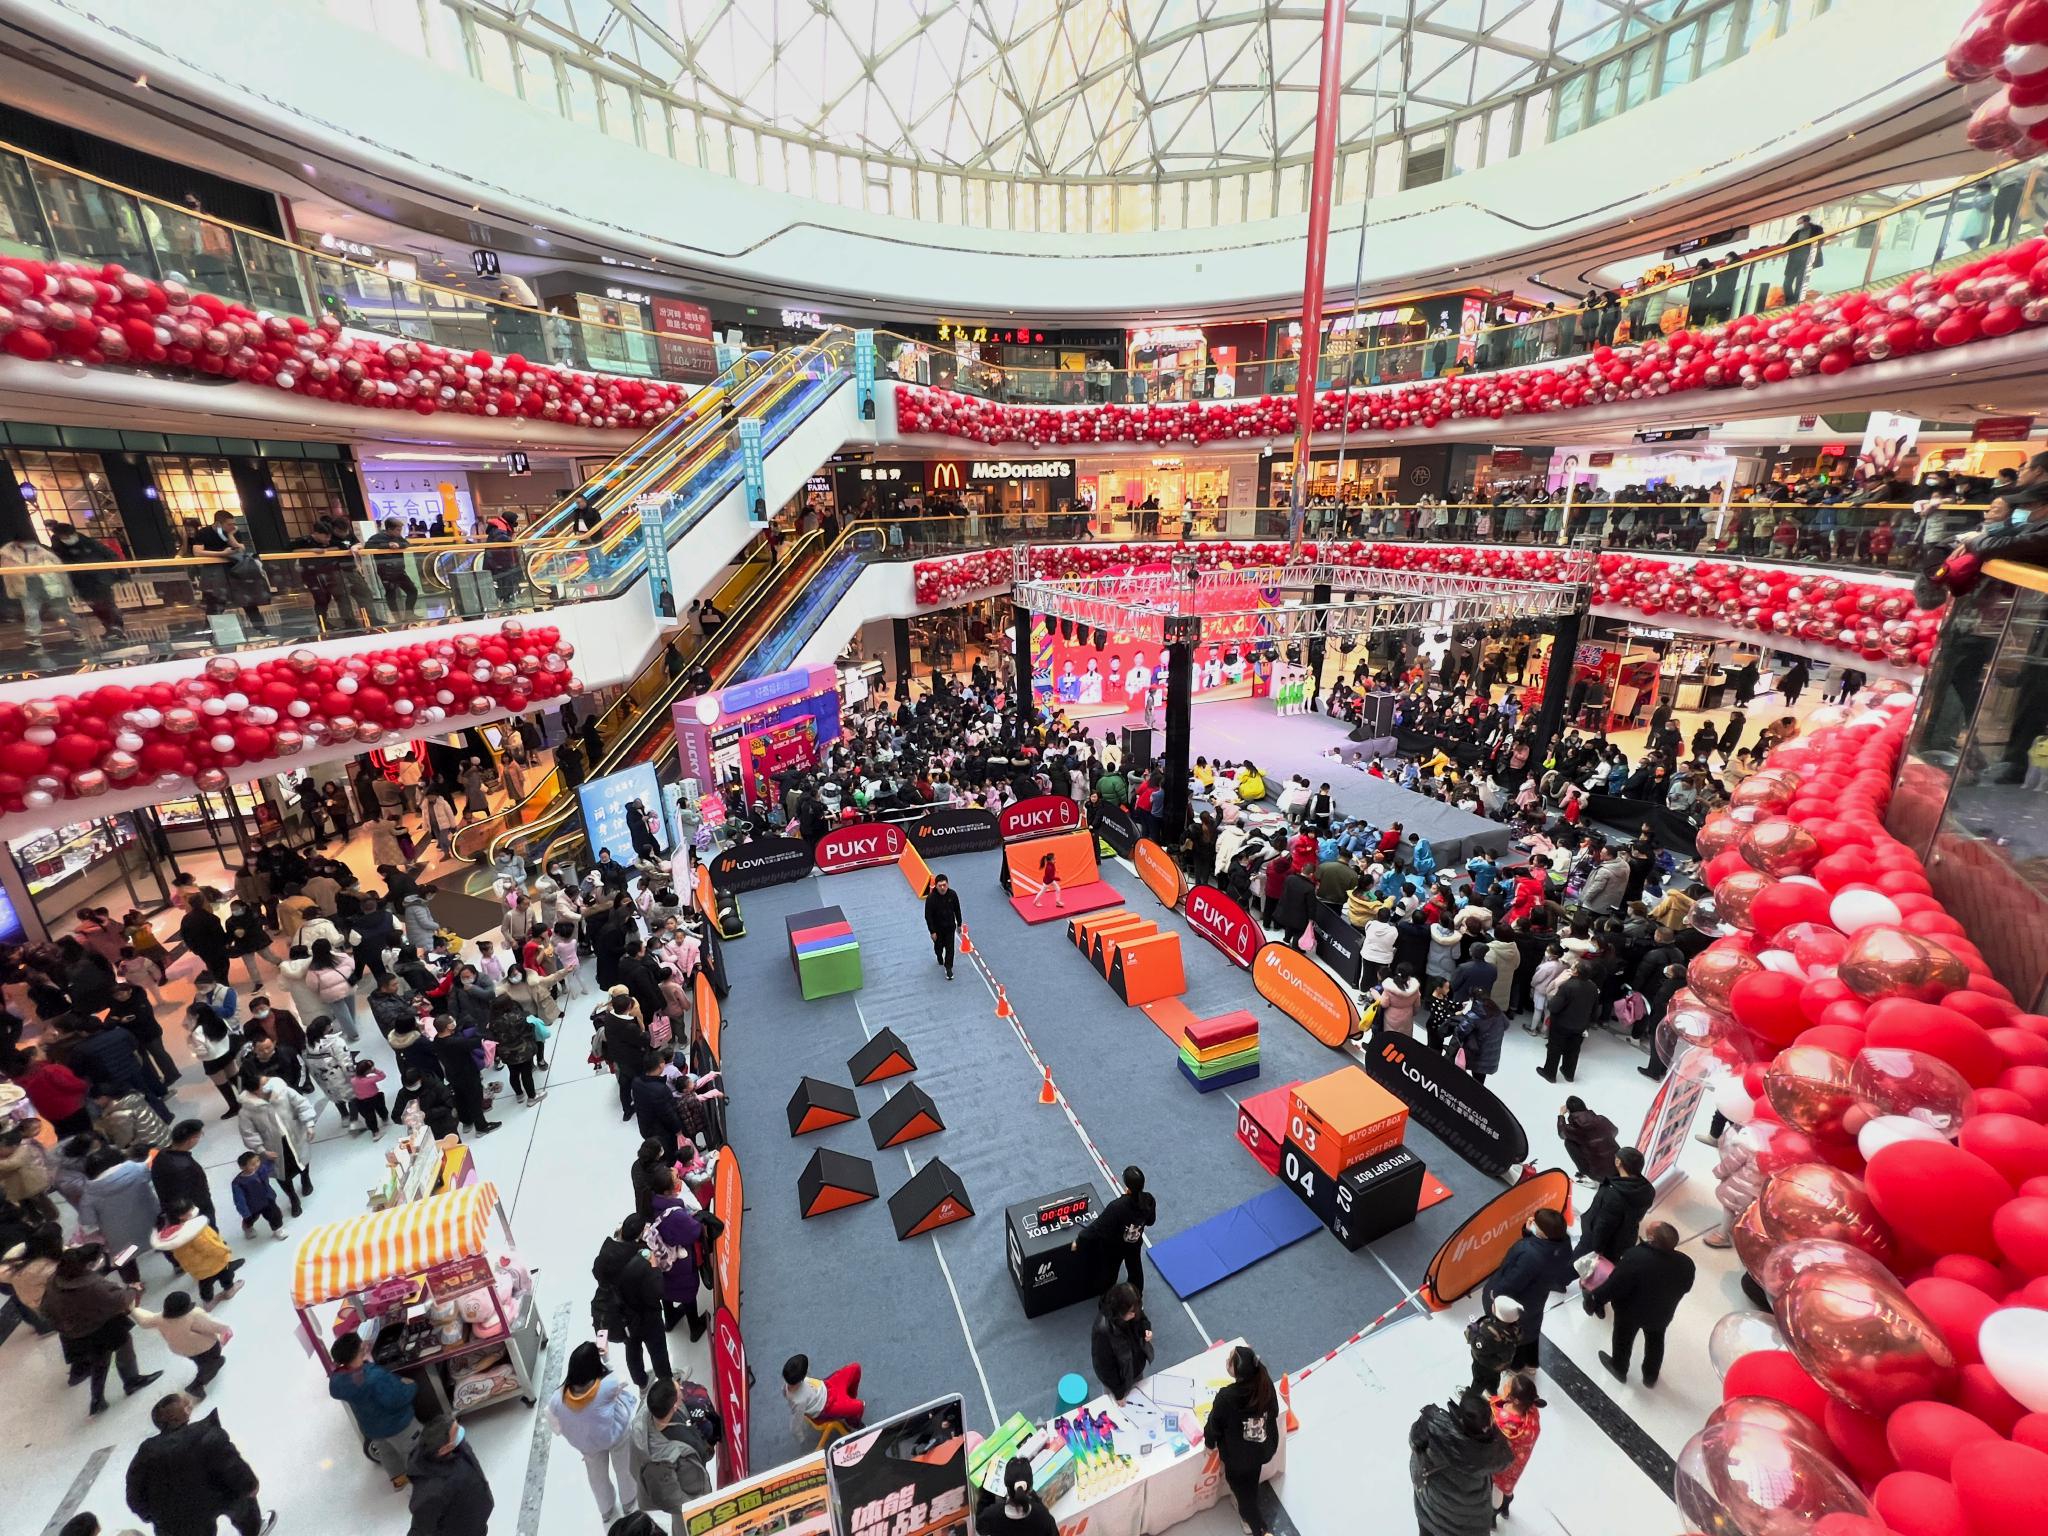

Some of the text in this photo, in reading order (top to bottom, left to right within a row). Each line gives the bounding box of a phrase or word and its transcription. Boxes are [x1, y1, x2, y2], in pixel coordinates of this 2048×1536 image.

[972, 461, 1071, 479] McDonald's
[382, 499, 462, 517] 天合口
[685, 732, 700, 777] LUCKY
[931, 826, 957, 837] LOVA
[1009, 808, 1054, 831] PUKY
[826, 837, 878, 860] PUKY
[736, 857, 766, 870] LOVA
[1194, 897, 1235, 936] PUKY
[1278, 965, 1303, 991] LOVA
[1402, 1062, 1439, 1098] LOVA
[1296, 1098, 1308, 1116] 01
[1240, 1115, 1259, 1147] 03
[1292, 1116, 1317, 1152] 03
[1348, 1115, 1402, 1144] PLYO SOFT BOX
[1346, 1137, 1400, 1166] PLYO SOFT BOX
[1286, 1152, 1315, 1199] 04
[1354, 1152, 1412, 1184] PLYO SOFT BOX
[1041, 1200, 1086, 1223] 00:00:00
[1336, 1185, 1353, 1213] 02
[1027, 1225, 1049, 1239] BOX
[1050, 1217, 1074, 1233] SFT
[1473, 1219, 1509, 1250] LOVA
[1034, 1270, 1055, 1282] LOVA
